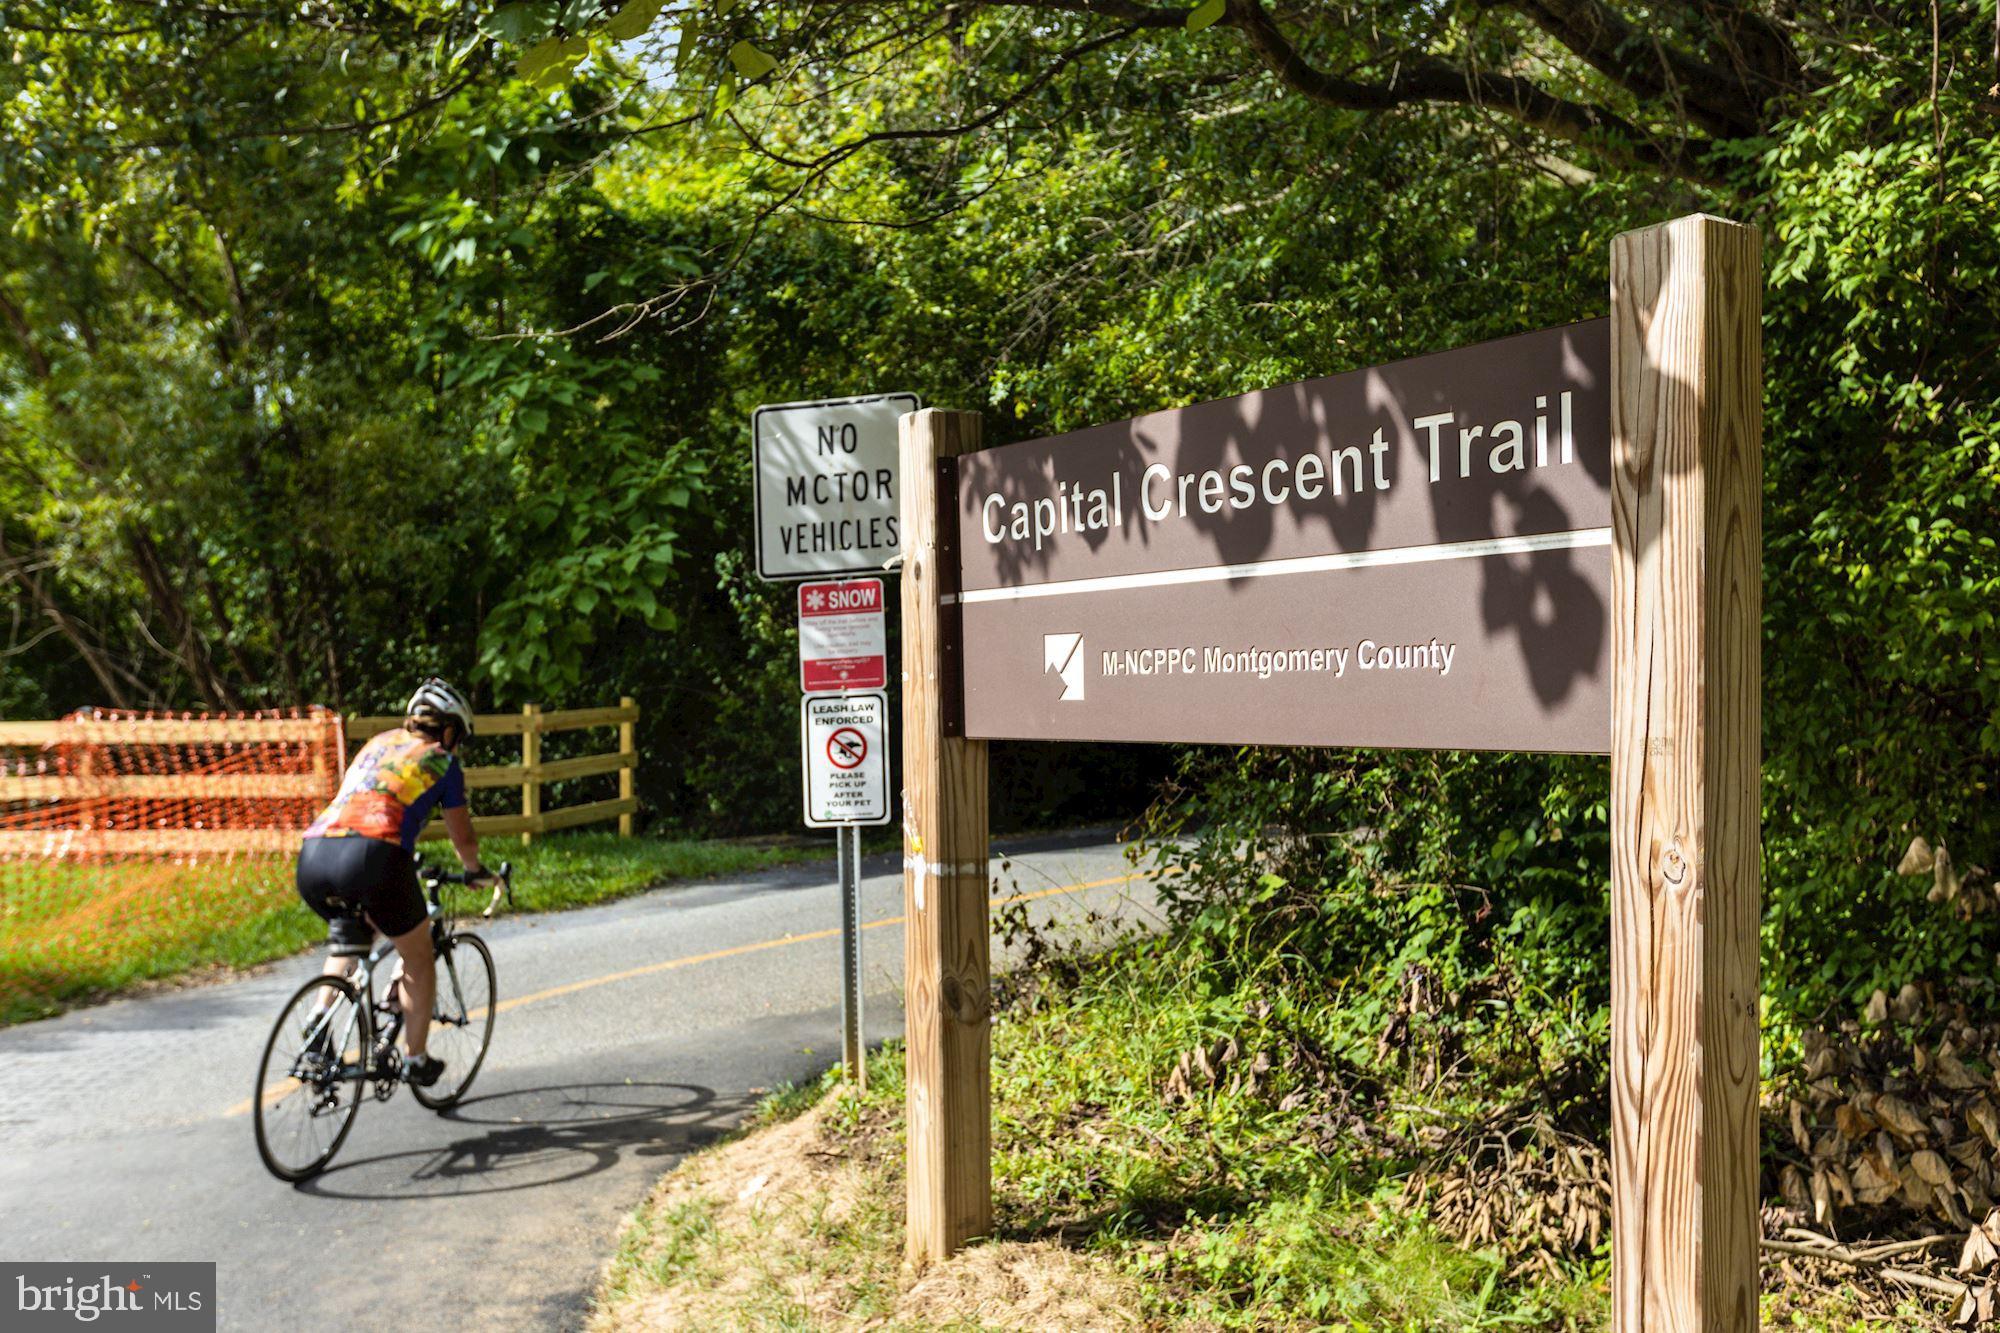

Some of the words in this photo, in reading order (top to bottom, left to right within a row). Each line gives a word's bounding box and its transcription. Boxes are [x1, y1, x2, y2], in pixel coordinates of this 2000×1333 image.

[817, 423, 858, 456] NO
[981, 471, 1122, 551] Capital
[1140, 427, 1391, 522] Crescent
[1413, 391, 1573, 483] Trail
[780, 516, 899, 555] VEHICLES
[828, 588, 876, 609] SNOW
[1102, 647, 1197, 676] M-NCPPC
[1202, 645, 1349, 679] Montgomery
[1356, 638, 1456, 676] County
[813, 704, 849, 714] LEASH
[851, 703, 875, 712] LAW
[815, 715, 874, 726] ENFORCED
[854, 780, 867, 788] UP
[833, 791, 864, 799] AFTER
[826, 800, 852, 808] YOUR
[854, 799, 872, 807] PET
